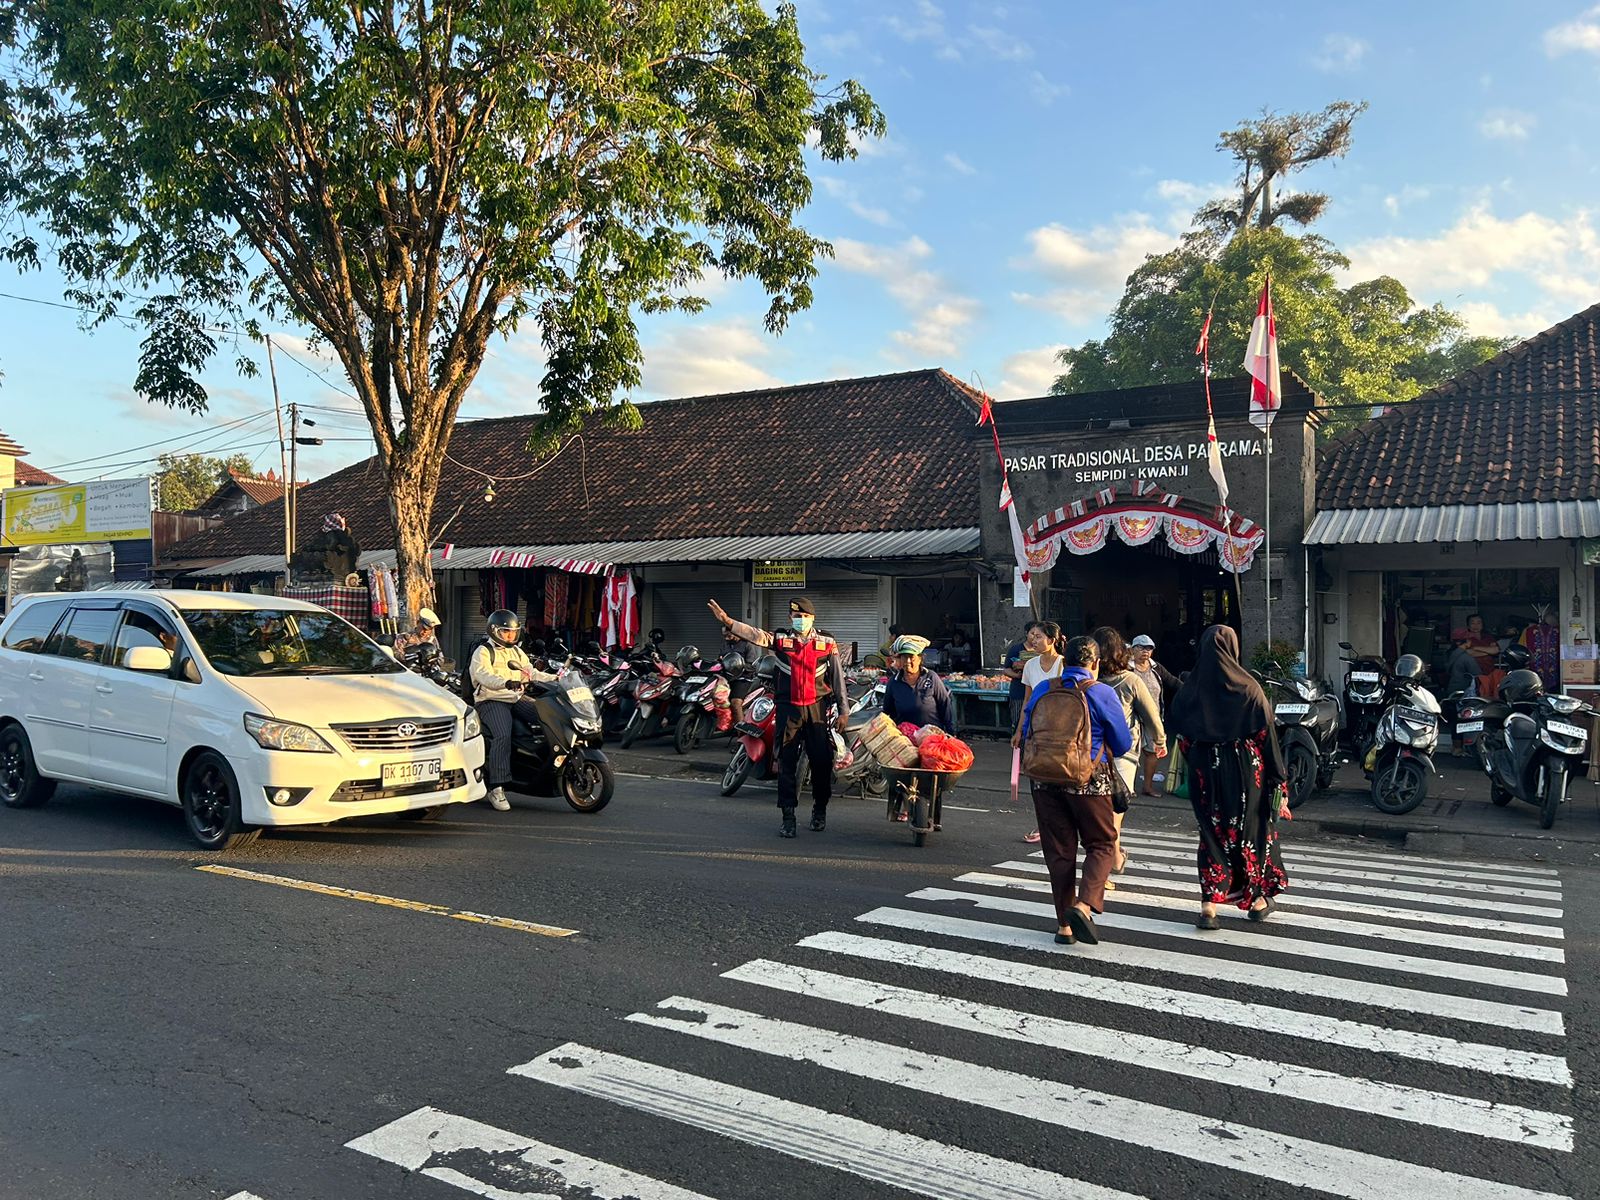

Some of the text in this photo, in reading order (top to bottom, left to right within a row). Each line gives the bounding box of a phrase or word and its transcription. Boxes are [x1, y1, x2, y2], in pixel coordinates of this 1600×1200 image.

[1004, 455, 1046, 473] PASAR
[1050, 448, 1140, 470] TRADISIONAL
[1144, 445, 1183, 463] DESA
[1075, 469, 1126, 483] SEMPIDI
[1138, 465, 1188, 479] KWANJI
[755, 567, 803, 575] DAGING SAPI
[384, 767, 396, 780] DK
[400, 763, 424, 778] 1107
